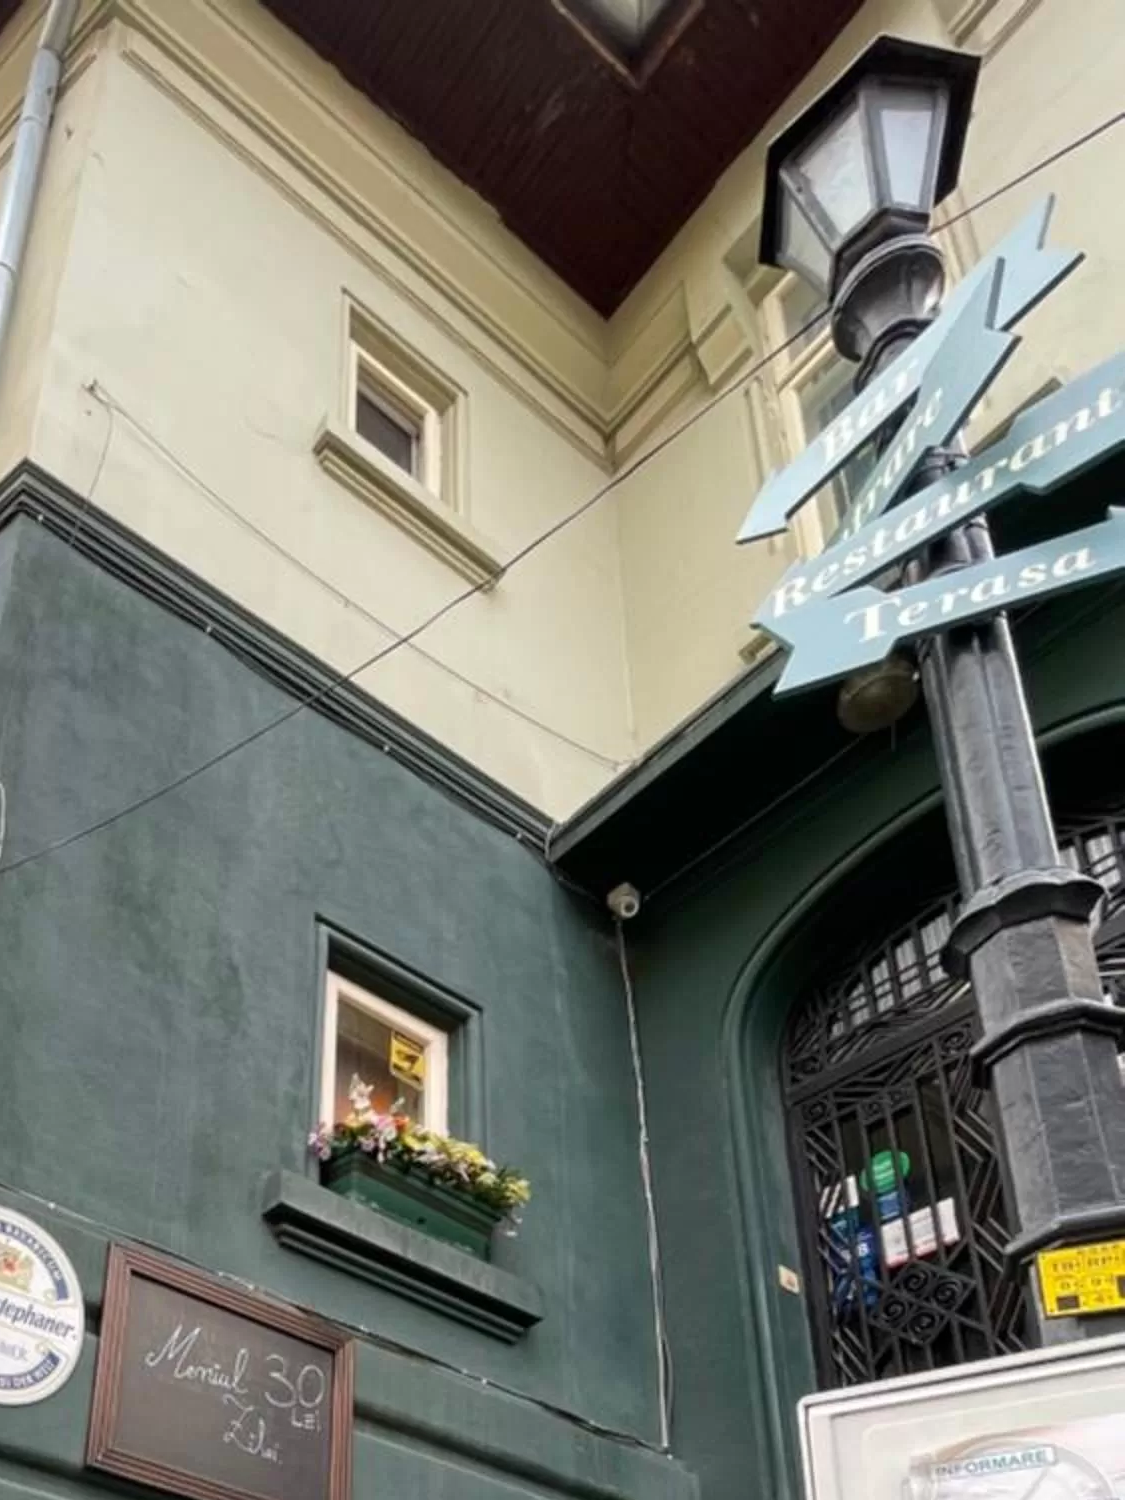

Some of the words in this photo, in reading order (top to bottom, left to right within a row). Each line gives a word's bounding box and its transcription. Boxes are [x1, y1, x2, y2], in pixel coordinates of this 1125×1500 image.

[820, 357, 918, 469] Bar
[772, 385, 1124, 620] Restaurant
[844, 546, 1098, 646] Terasa
[145, 1323, 250, 1395] Meniul
[264, 1354, 326, 1409] 30
